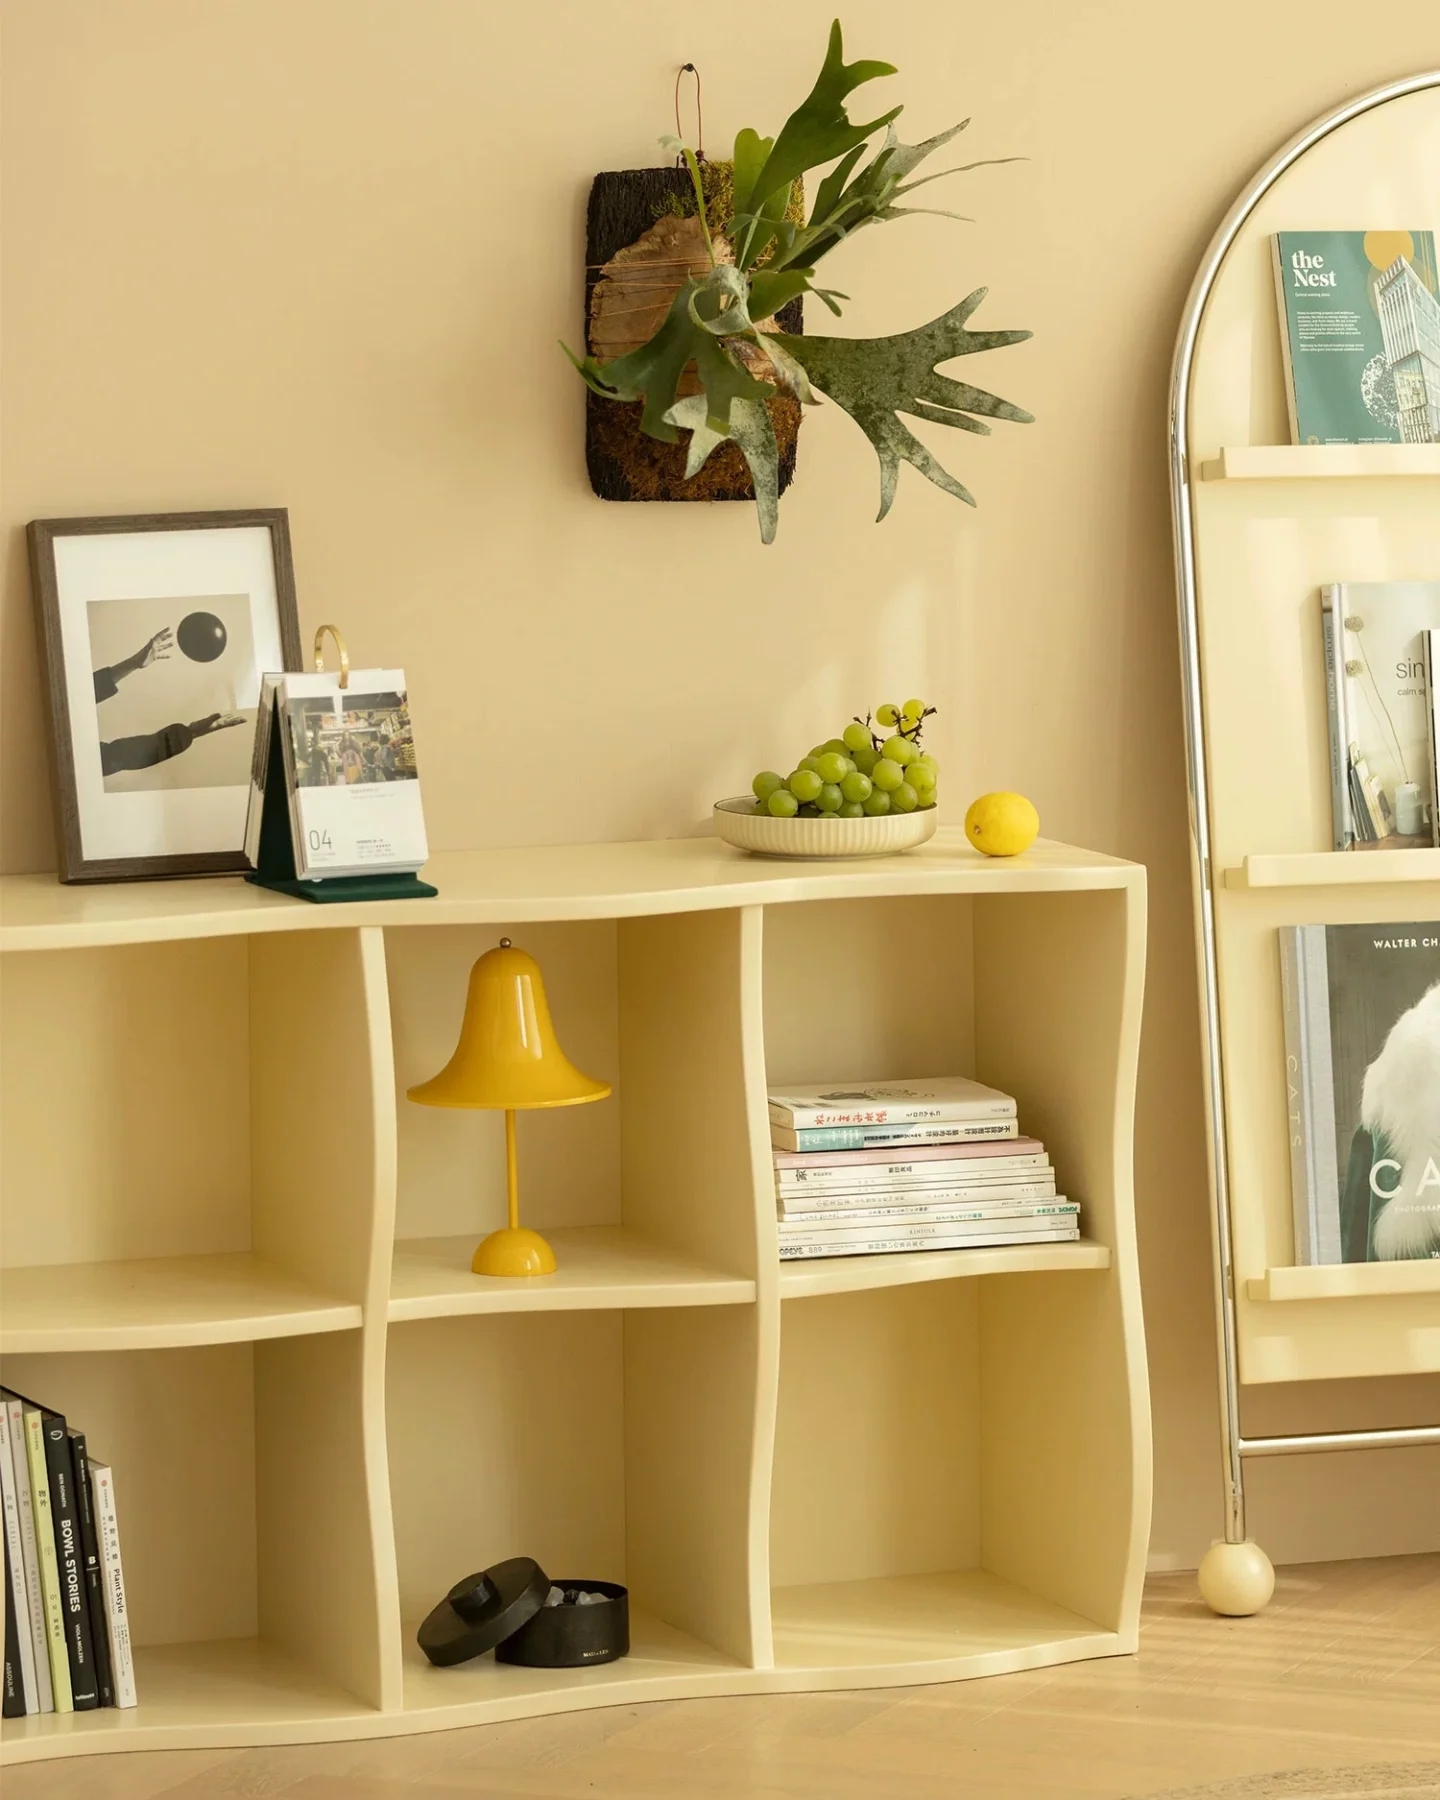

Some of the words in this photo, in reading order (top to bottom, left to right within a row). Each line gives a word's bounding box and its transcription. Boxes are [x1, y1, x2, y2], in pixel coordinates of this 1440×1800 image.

[1291, 250, 1324, 269] the
[1293, 269, 1337, 287] Nest
[309, 829, 332, 851] 04
[1373, 938, 1417, 949] WALTER
[1422, 937, 1440, 948] CH
[1286, 1054, 1302, 1147] CATS
[779, 1246, 804, 1256] OPEYE
[61, 1519, 74, 1557] BOWL
[88, 1555, 97, 1565] B
[65, 1560, 81, 1613] STORIES
[113, 1568, 122, 1592] Plant
[115, 1592, 124, 1614] Style
[5, 1661, 15, 1698] ASSOULINE
